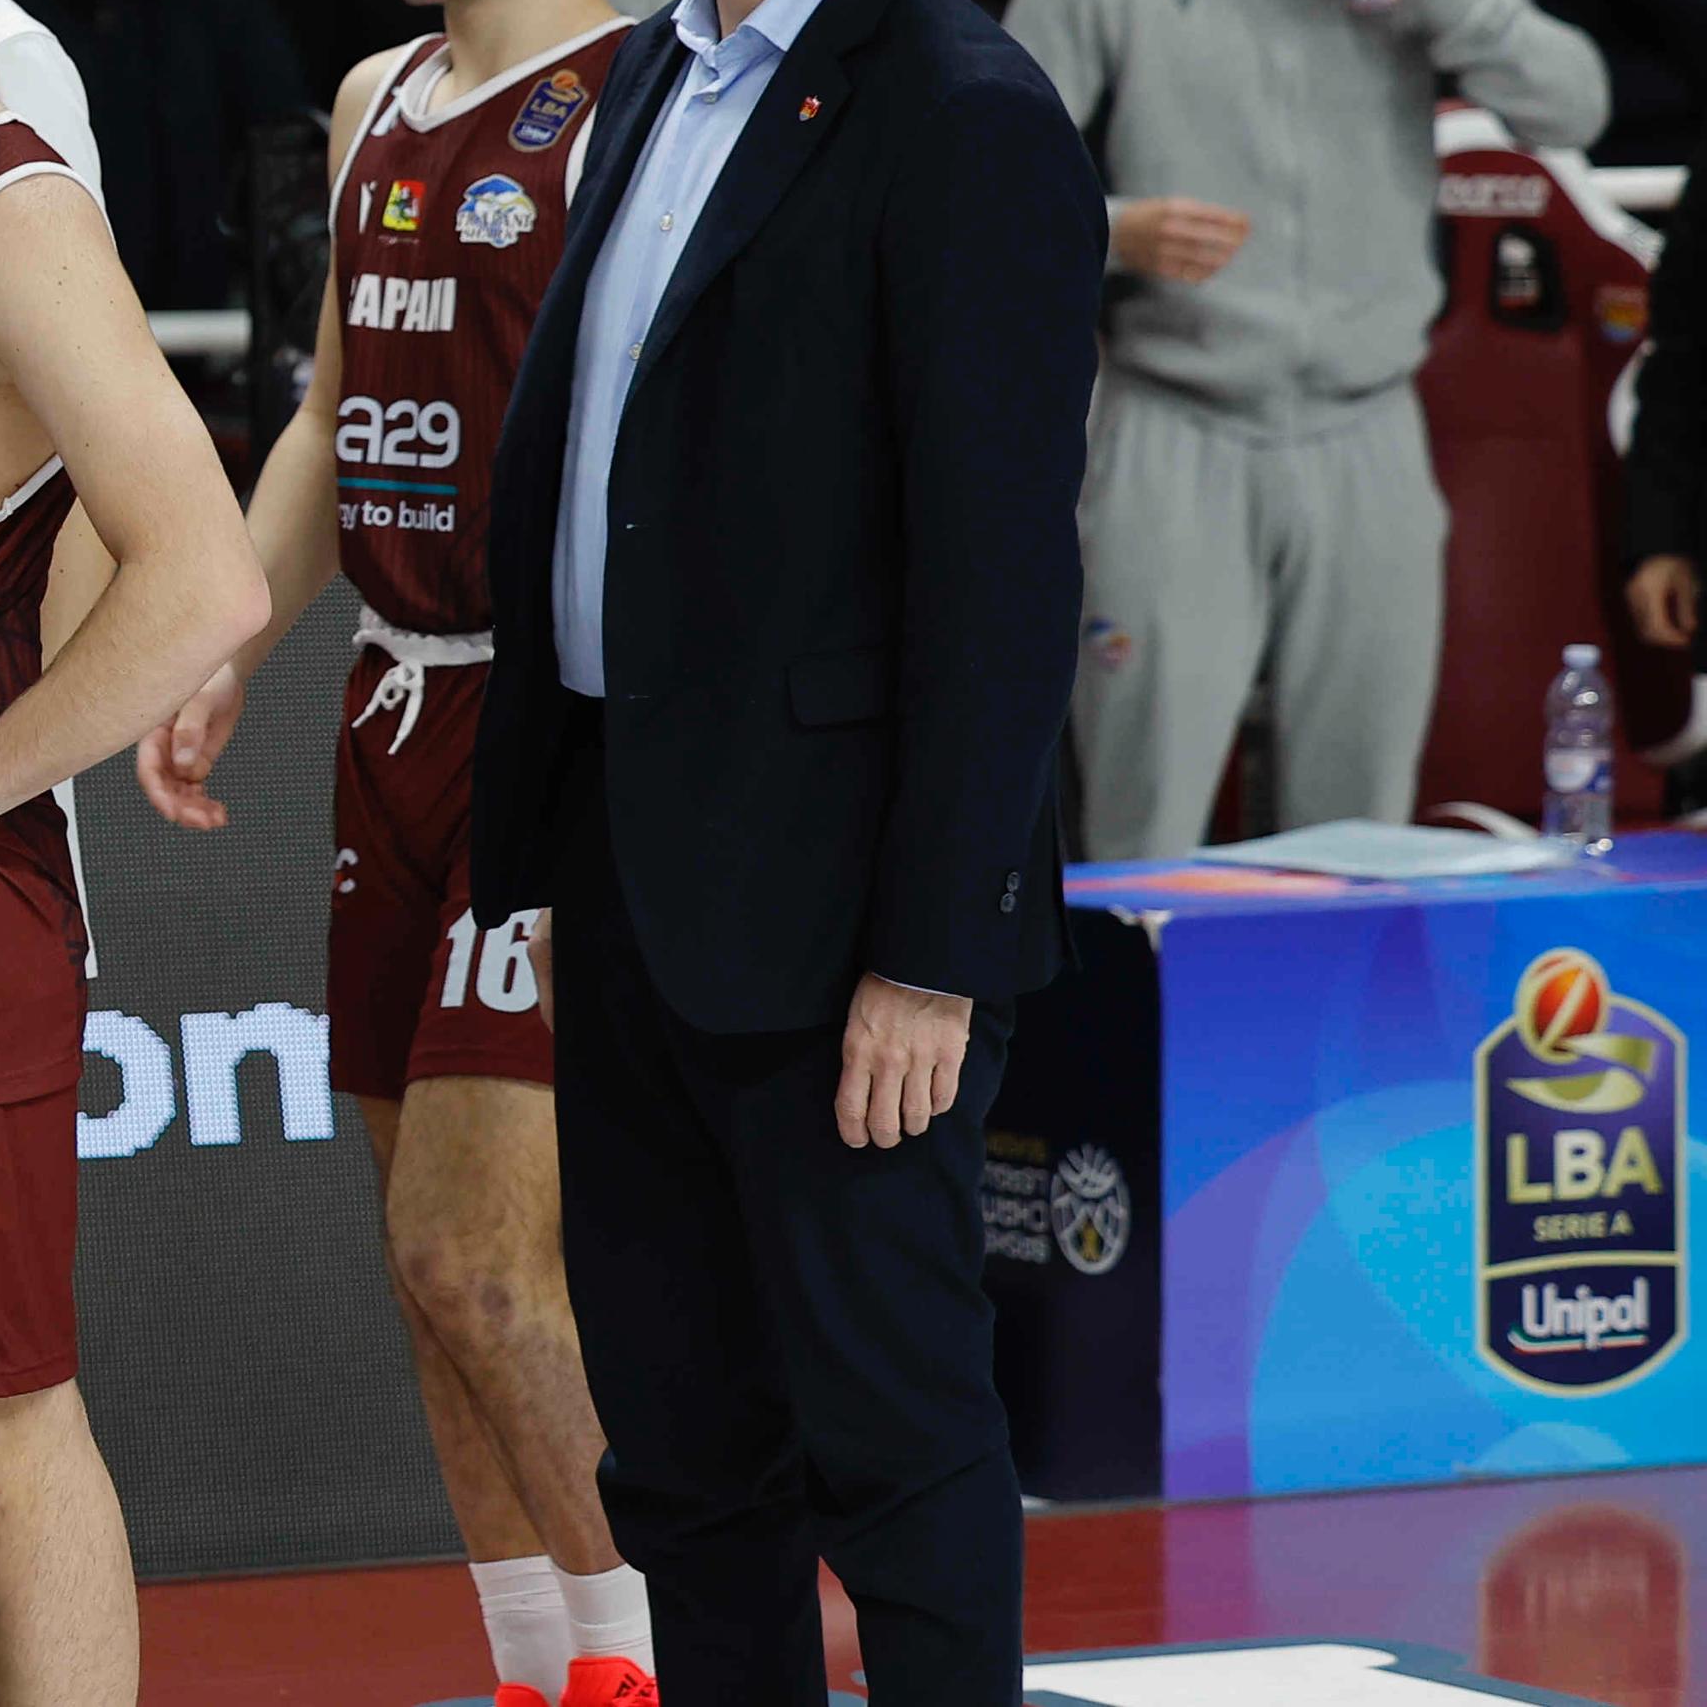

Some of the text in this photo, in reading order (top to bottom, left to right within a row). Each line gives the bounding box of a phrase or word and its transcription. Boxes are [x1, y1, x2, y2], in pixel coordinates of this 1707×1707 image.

[349, 272, 457, 332] APANI
[335, 395, 461, 469] a29
[361, 499, 393, 527] to
[397, 499, 455, 532] build
[440, 906, 542, 1014] 16
[1505, 1125, 1664, 1205] LBA
[1532, 1209, 1634, 1243] SERIE A
[1522, 1275, 1650, 1353] Unipol
